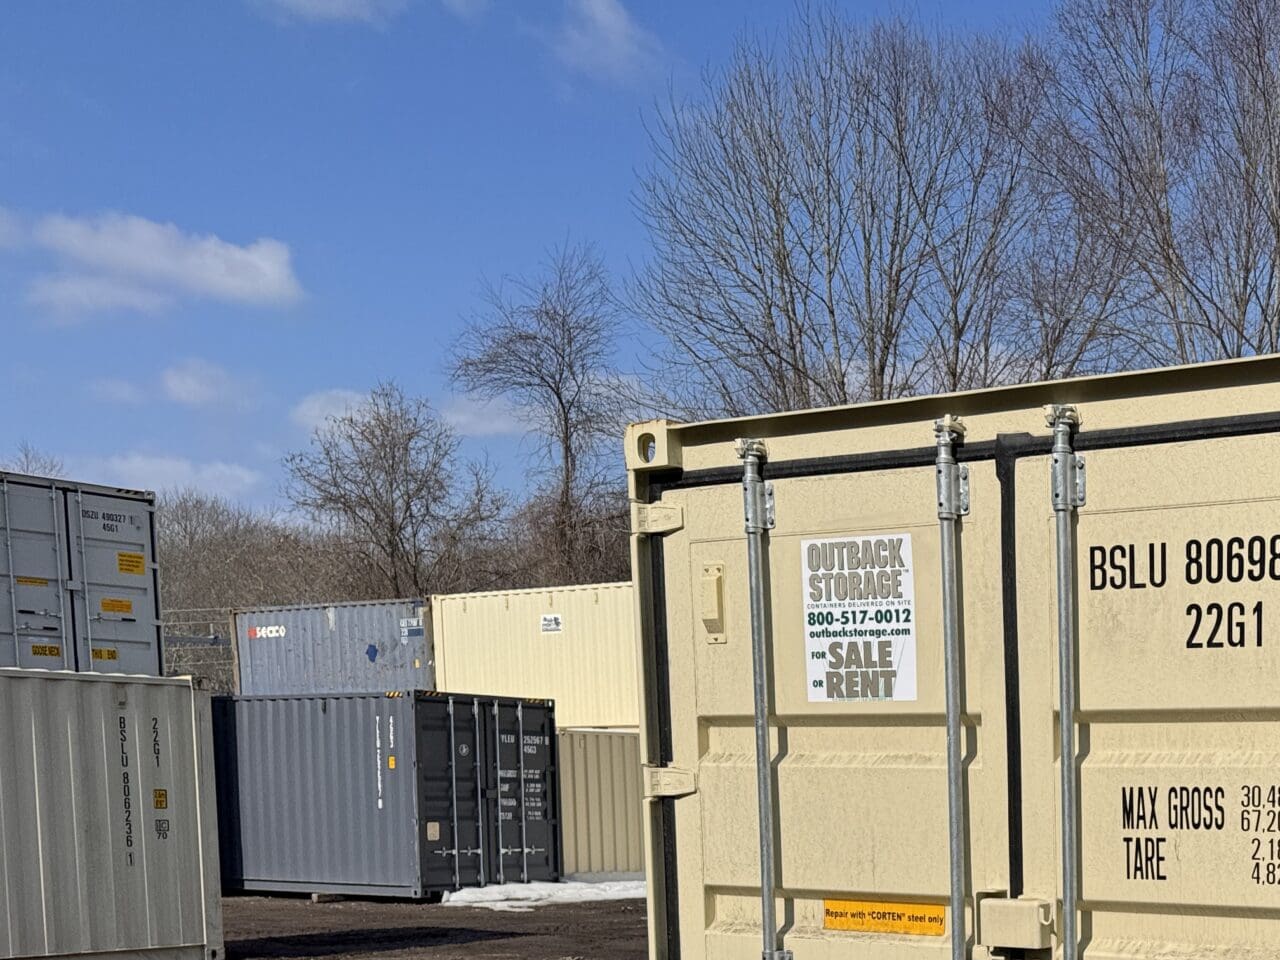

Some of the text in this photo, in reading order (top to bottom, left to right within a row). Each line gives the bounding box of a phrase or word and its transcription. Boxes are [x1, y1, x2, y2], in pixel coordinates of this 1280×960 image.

[807, 538, 905, 572] OUTBACK
[1090, 542, 1167, 590] BSLU
[808, 570, 903, 602] STORAGE
[807, 608, 911, 626] 800-517-0012
[809, 627, 911, 639] outbackstorage.com
[1186, 601, 1263, 649] 22G1
[811, 640, 893, 670] FOR SALE
[812, 670, 897, 699] OR RENT
[119, 716, 128, 768] BSLU
[152, 717, 160, 768] 22G1
[122, 771, 133, 848] 806236
[1122, 786, 1159, 830] MAX
[1168, 786, 1225, 831] GROSS
[1123, 837, 1167, 881] TARE
[825, 908, 848, 920] Repair
[850, 911, 866, 919] with
[907, 914, 927, 923] steel
[928, 915, 944, 926] only
